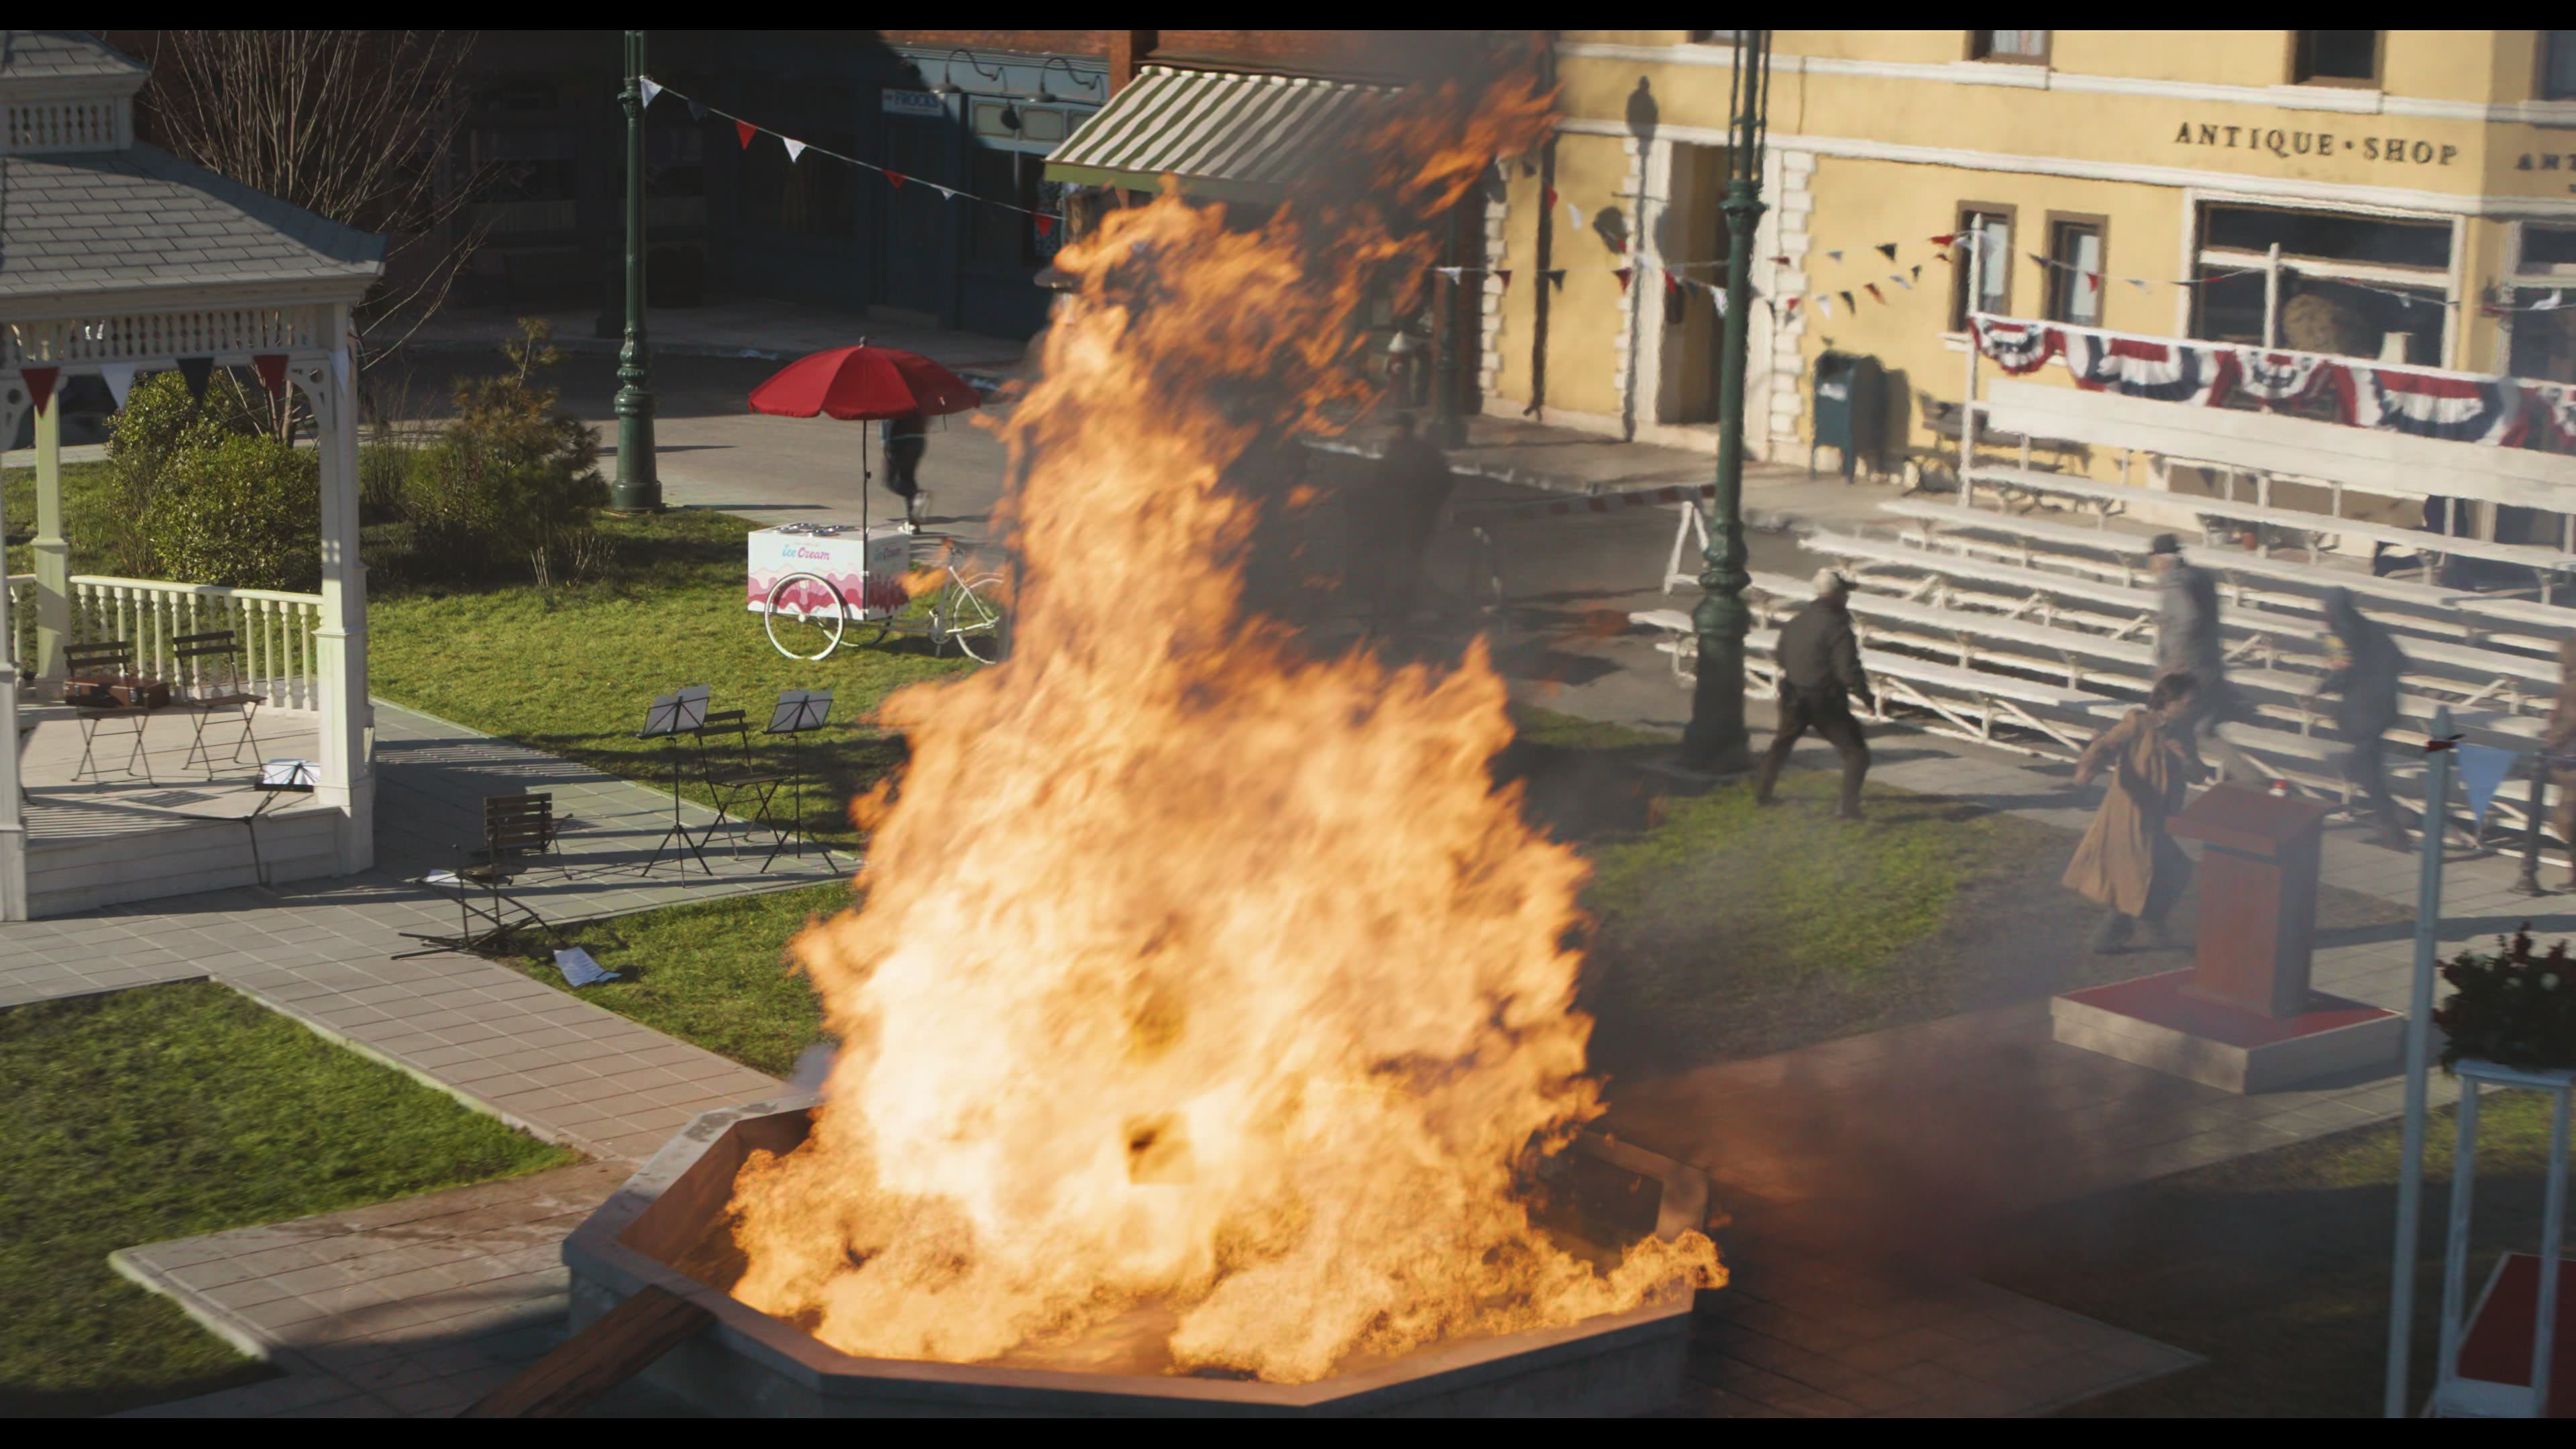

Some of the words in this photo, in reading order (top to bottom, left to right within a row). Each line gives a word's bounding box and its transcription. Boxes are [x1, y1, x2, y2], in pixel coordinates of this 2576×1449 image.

[2175, 121, 2334, 158] ANTIQUE
[2363, 137, 2459, 166] SHOP
[798, 547, 829, 561] Cream
